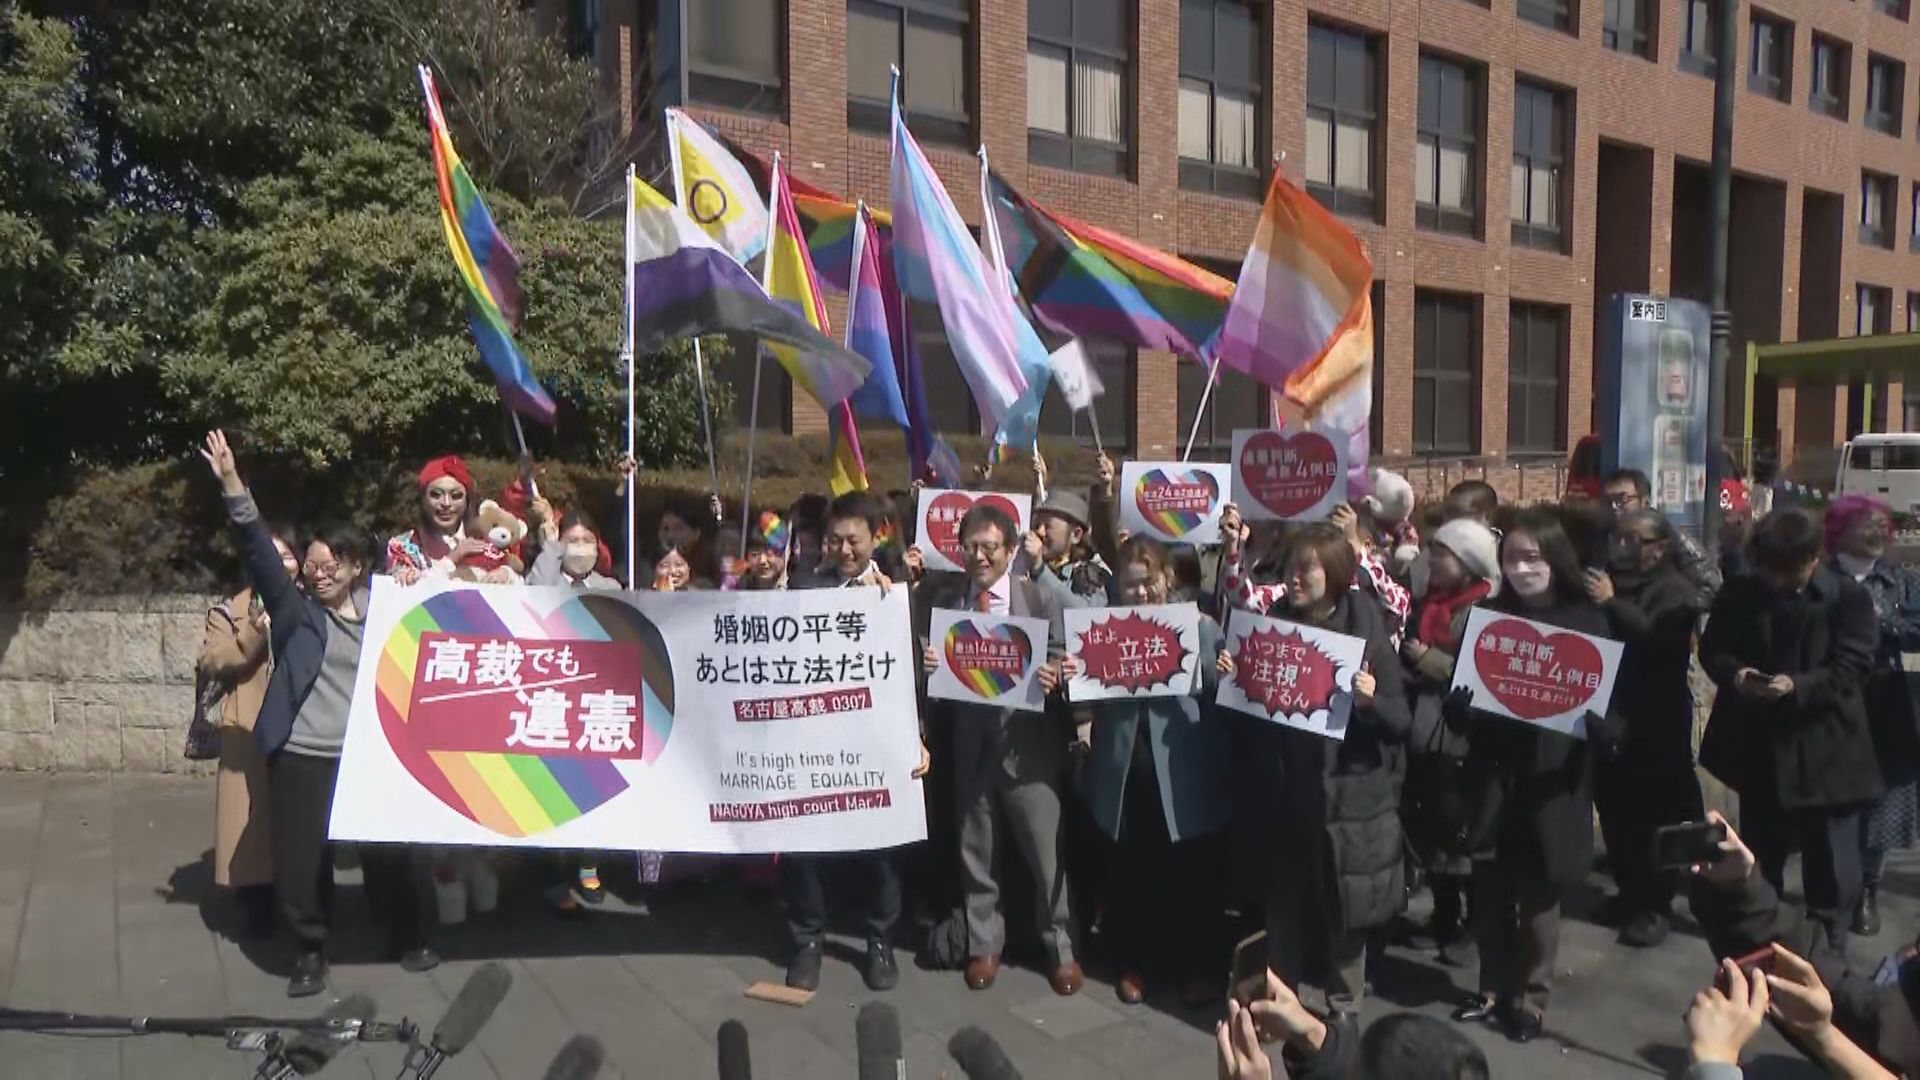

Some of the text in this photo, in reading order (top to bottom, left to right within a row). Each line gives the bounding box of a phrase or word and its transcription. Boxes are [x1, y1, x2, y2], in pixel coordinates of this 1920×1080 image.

[1631, 301, 1666, 320] 案内図
[714, 610, 867, 645] 婚姻の平等
[1087, 627, 1119, 645] はよ
[1117, 634, 1168, 661] 立法
[1245, 637, 1307, 663] いつまで
[1478, 632, 1556, 663] 違憲判断
[423, 638, 581, 687] 高裁でも
[696, 650, 896, 685] あとは立法だけ
[739, 694, 867, 719] 名古屋高裁 0307
[1264, 684, 1310, 709] するん
[504, 687, 638, 753] 違憲
[736, 749, 863, 772] It's high time for
[719, 770, 886, 791] MARRIAGE EQUALITY
[712, 803, 765, 820] NAGOYA
[768, 802, 799, 818] high
[802, 799, 841, 815] court
